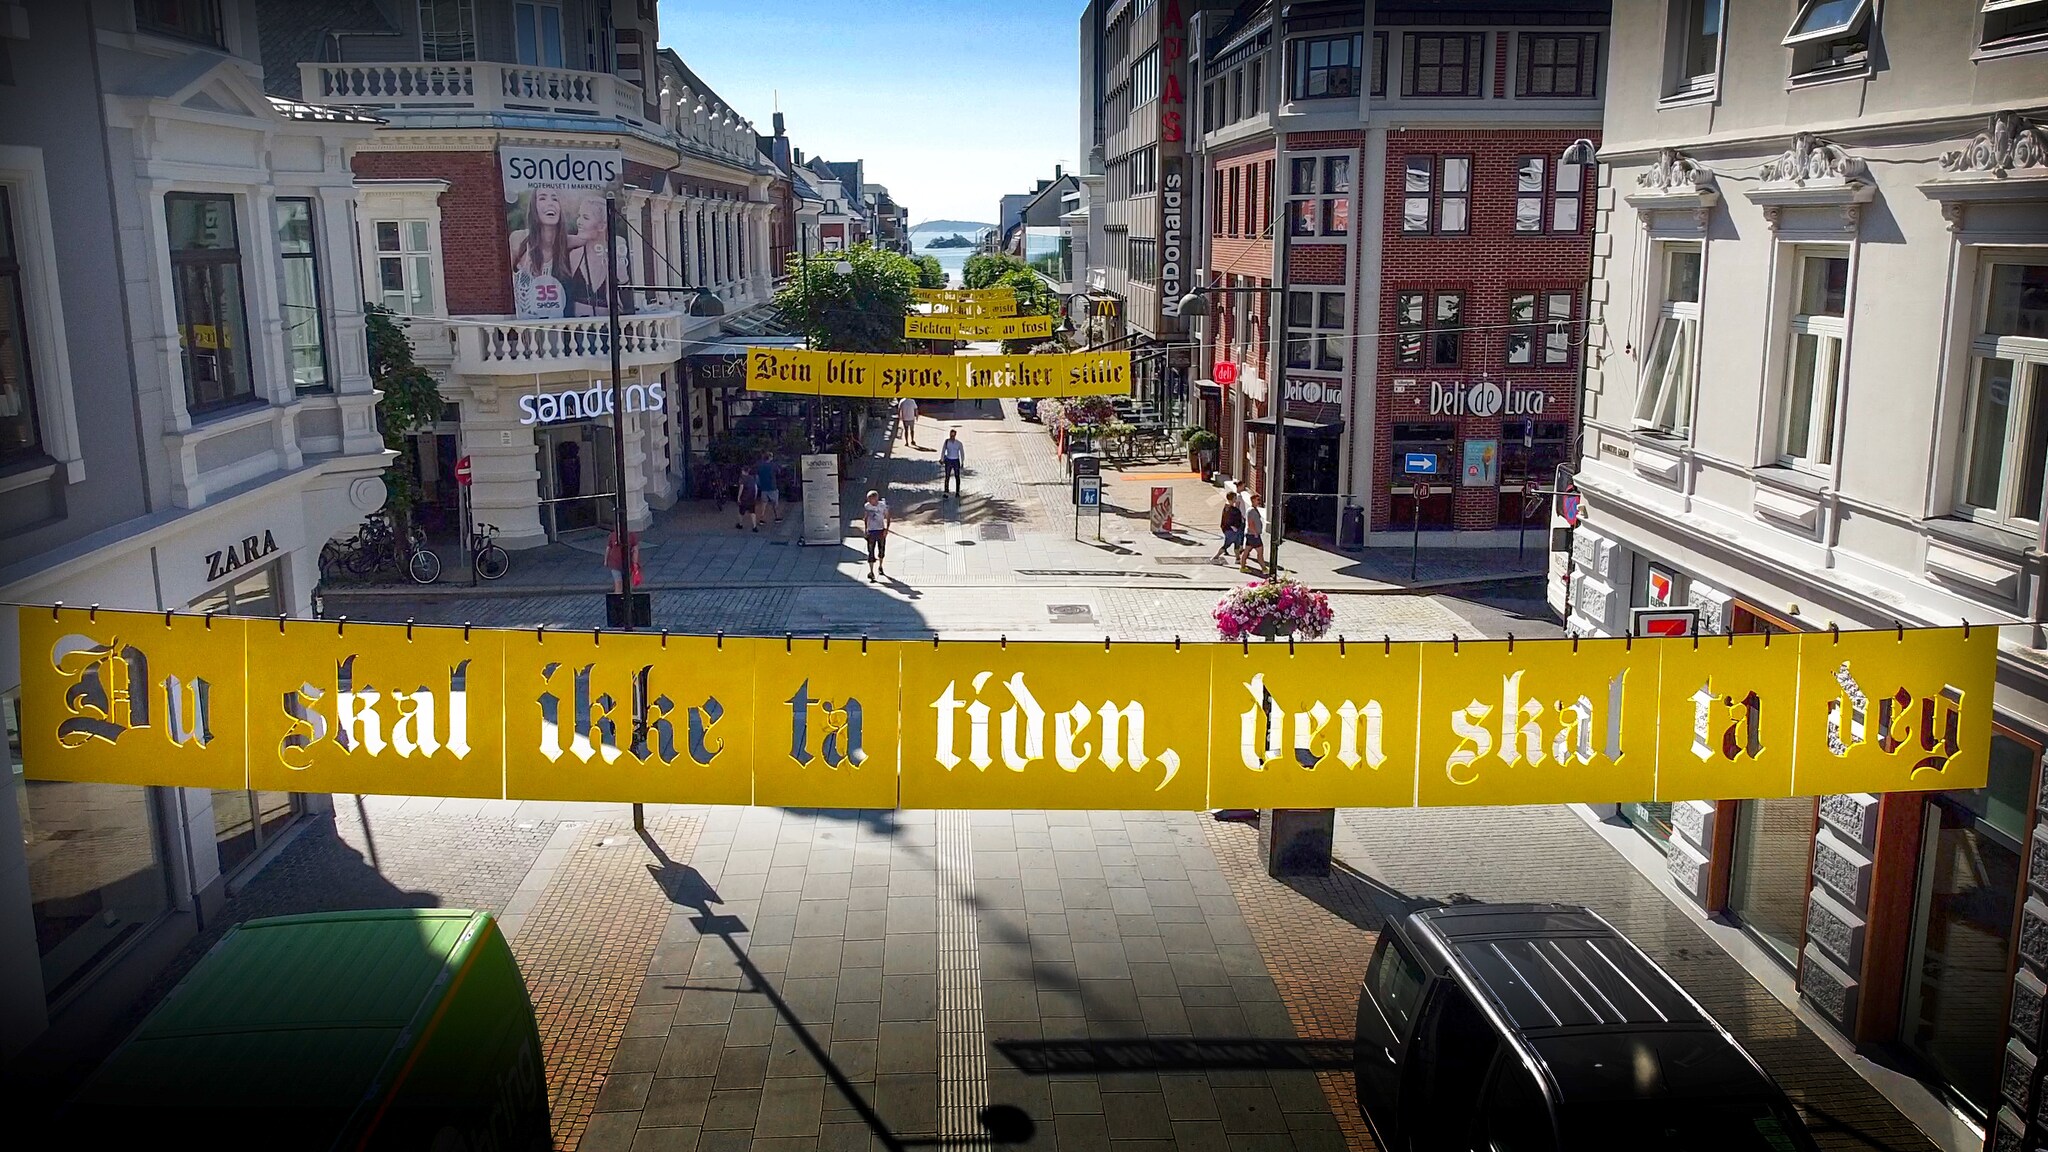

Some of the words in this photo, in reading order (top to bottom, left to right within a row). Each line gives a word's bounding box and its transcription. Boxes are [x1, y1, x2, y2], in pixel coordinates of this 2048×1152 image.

[509, 153, 616, 182] sandens
[527, 182, 566, 190] MOTEHUSET
[570, 183, 602, 191] MARKENS
[1162, 173, 1182, 317] McDonald's
[535, 285, 559, 301] 35
[1003, 324, 1015, 335] av
[1022, 321, 1048, 334] frost
[754, 352, 812, 383] Bein
[826, 358, 867, 384] blir
[882, 366, 950, 394] sprøe,
[965, 360, 1053, 389] knekker
[1070, 357, 1124, 388] stille
[1217, 366, 1232, 380] deli
[519, 379, 665, 425] sandens
[1284, 379, 1303, 401] Deli
[1306, 382, 1317, 401] de
[1321, 379, 1342, 404] Luca
[1430, 380, 1466, 416] Deli
[1475, 384, 1497, 414] de
[1505, 380, 1544, 415] Luca
[205, 529, 279, 582] ZARA
[50, 633, 214, 750] Du
[278, 653, 474, 770] skal
[535, 661, 726, 768] ikke
[783, 677, 871, 771] ta
[929, 671, 1182, 792] tiden,
[1240, 672, 1388, 773] den
[1445, 666, 1632, 786] skal
[1686, 675, 1768, 764] ta
[1827, 660, 1968, 782] deg
